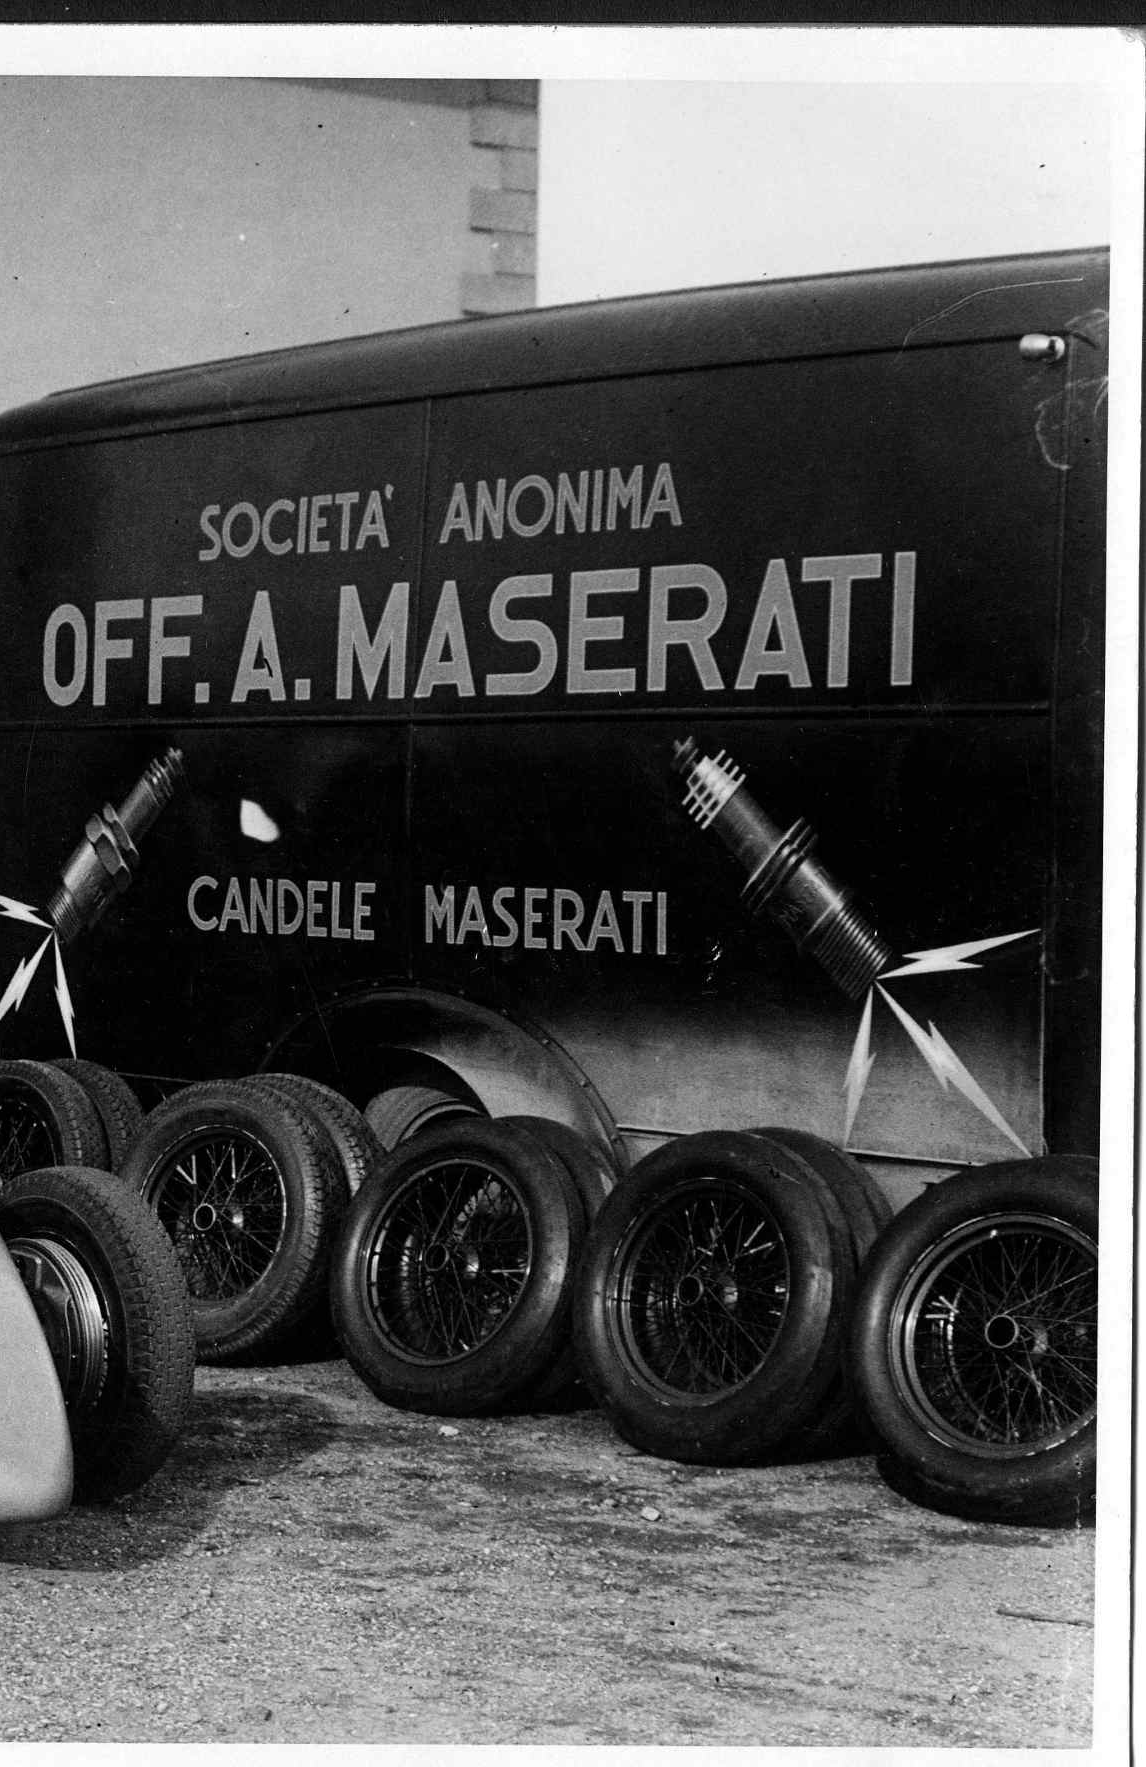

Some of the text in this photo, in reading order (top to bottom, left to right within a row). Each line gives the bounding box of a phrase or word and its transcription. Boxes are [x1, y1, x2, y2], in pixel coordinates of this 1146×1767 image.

[438, 462, 683, 545] ANONIMA
[42, 551, 917, 707] OFF. A. MASERATI
[187, 875, 668, 956] CANDELE MASERATI
